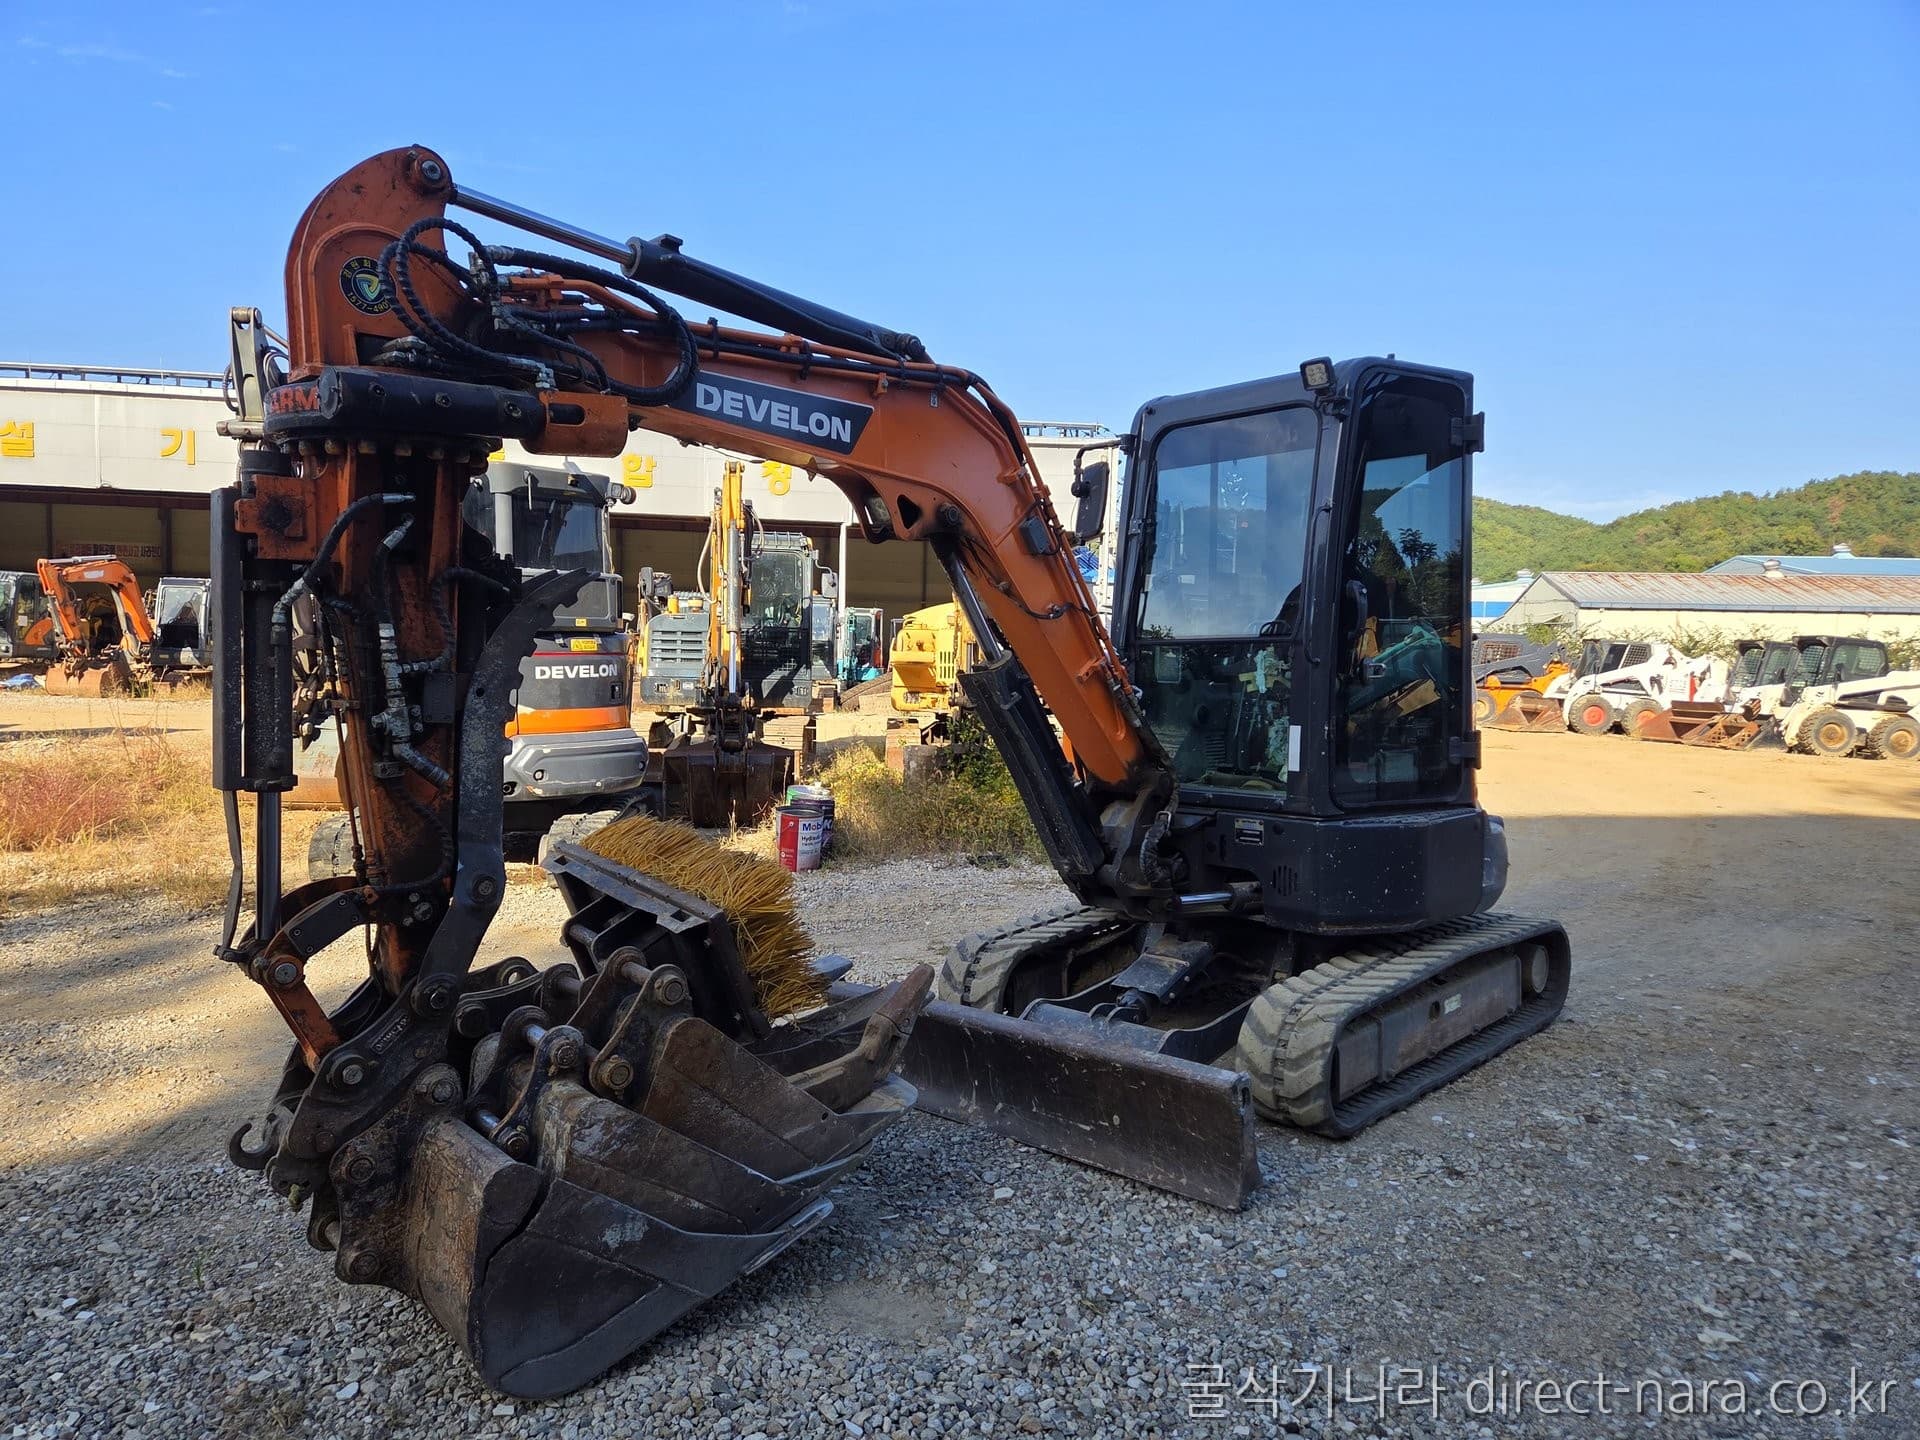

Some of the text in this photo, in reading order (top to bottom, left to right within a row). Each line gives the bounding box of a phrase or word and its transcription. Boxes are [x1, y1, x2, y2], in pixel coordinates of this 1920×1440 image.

[696, 382, 850, 443] DEVELON
[160, 428, 195, 465] 기
[534, 664, 618, 680] DEVELON
